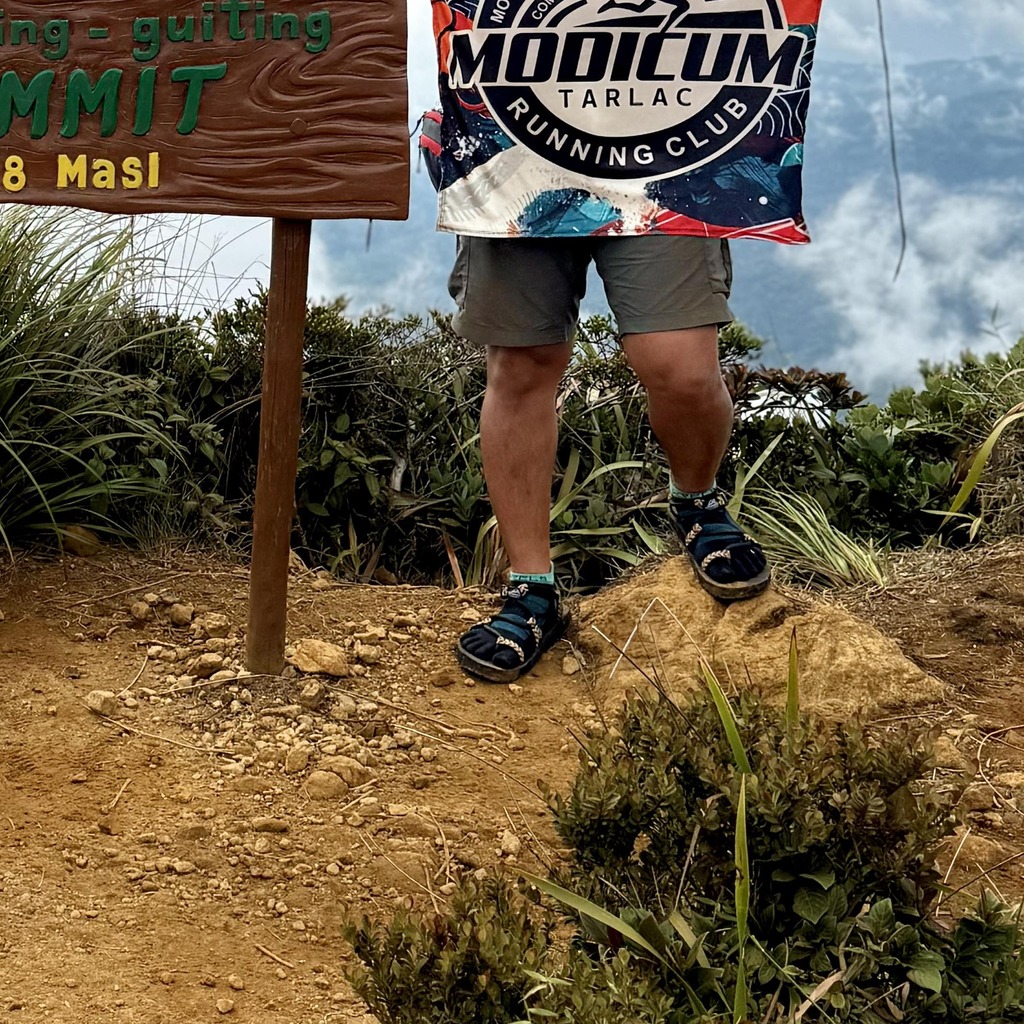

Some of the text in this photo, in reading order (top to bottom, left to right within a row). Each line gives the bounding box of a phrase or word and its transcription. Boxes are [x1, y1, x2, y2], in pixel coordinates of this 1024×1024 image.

[450, 32, 804, 86] MODICUM
[558, 87, 692, 108] TARLAC
[506, 96, 748, 167] RUNNING CLUB
[56, 152, 160, 189] Masl
